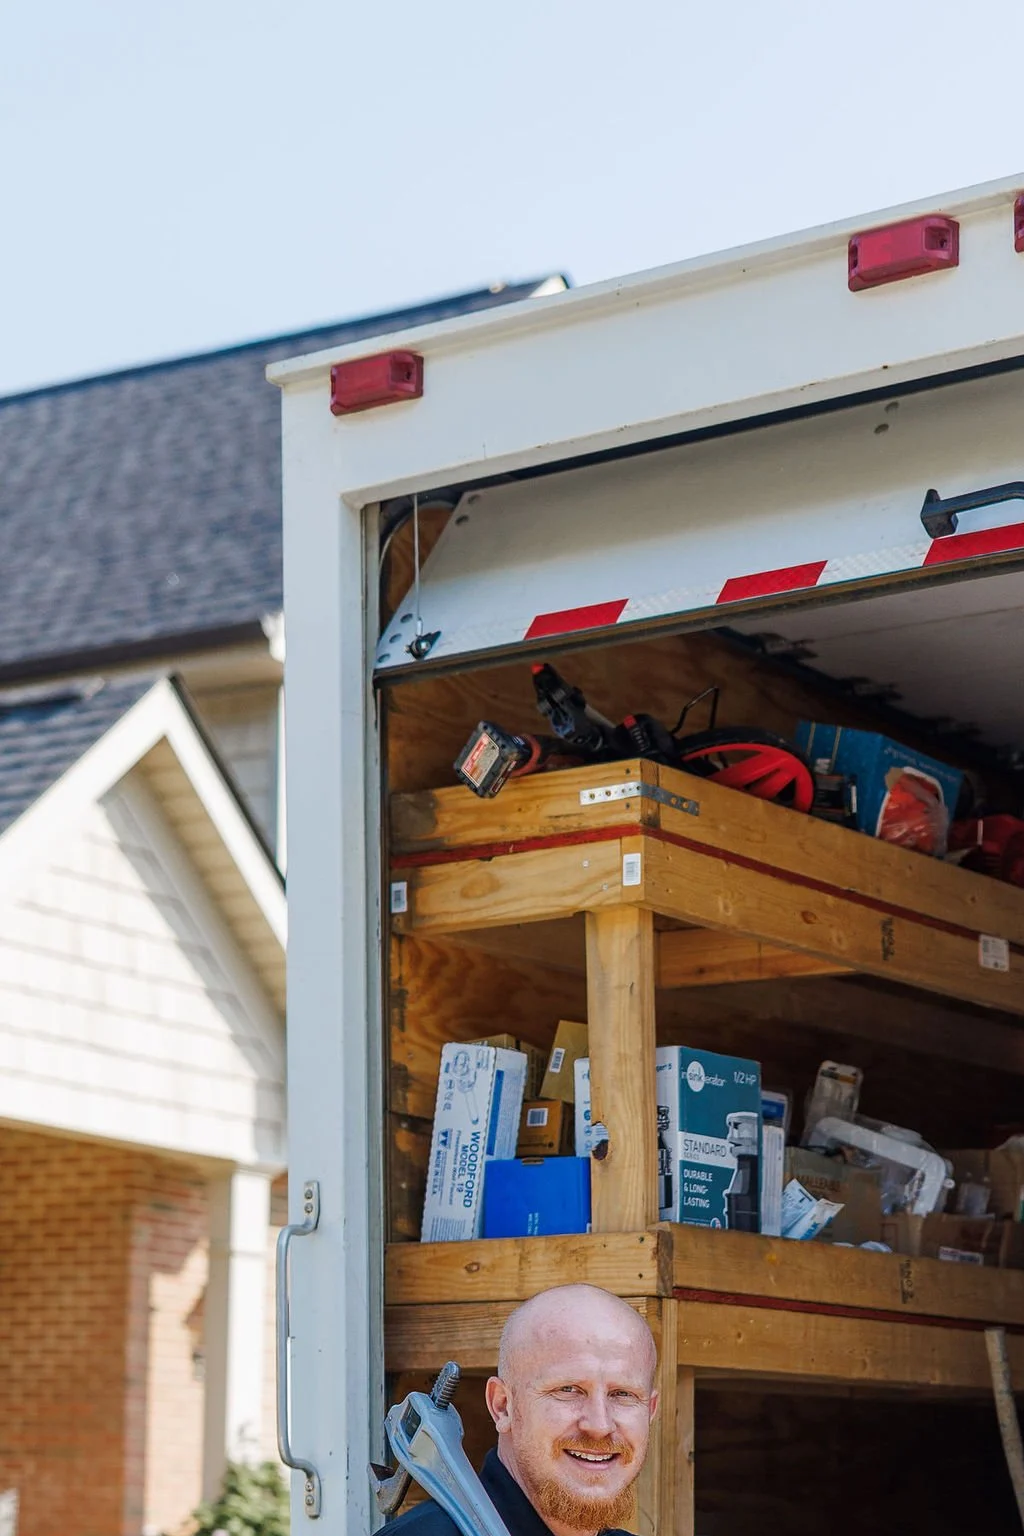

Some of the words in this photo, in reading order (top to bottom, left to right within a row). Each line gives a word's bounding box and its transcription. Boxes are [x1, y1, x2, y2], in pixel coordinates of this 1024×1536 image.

[733, 1071, 745, 1084] 1/2
[745, 1073, 757, 1086] HP
[683, 1139, 727, 1158] STANDARD
[459, 1144, 469, 1178] MODEL
[462, 1131, 481, 1208] WOODFORD
[683, 1168, 713, 1182] DURABLE
[683, 1183, 689, 1192] &
[689, 1184, 709, 1194] LONG-
[683, 1196, 710, 1209] LASTING
